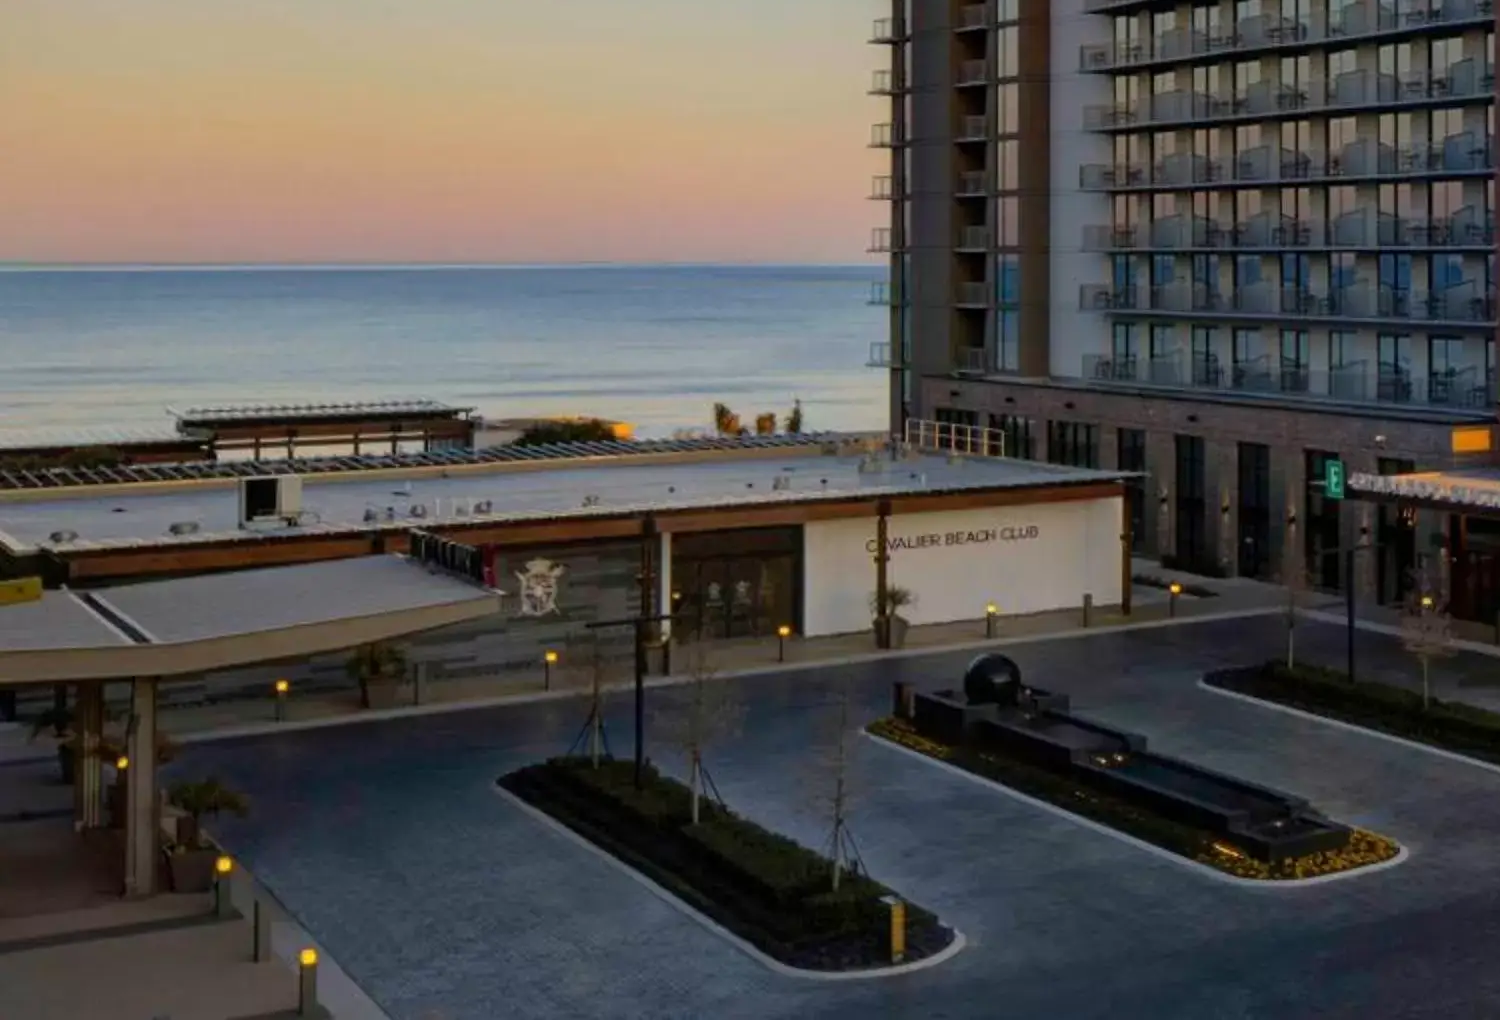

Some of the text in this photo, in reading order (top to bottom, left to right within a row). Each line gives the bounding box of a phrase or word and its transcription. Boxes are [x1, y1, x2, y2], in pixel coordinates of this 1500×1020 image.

[865, 525, 1040, 553] CVALIER BEACH CLUB
